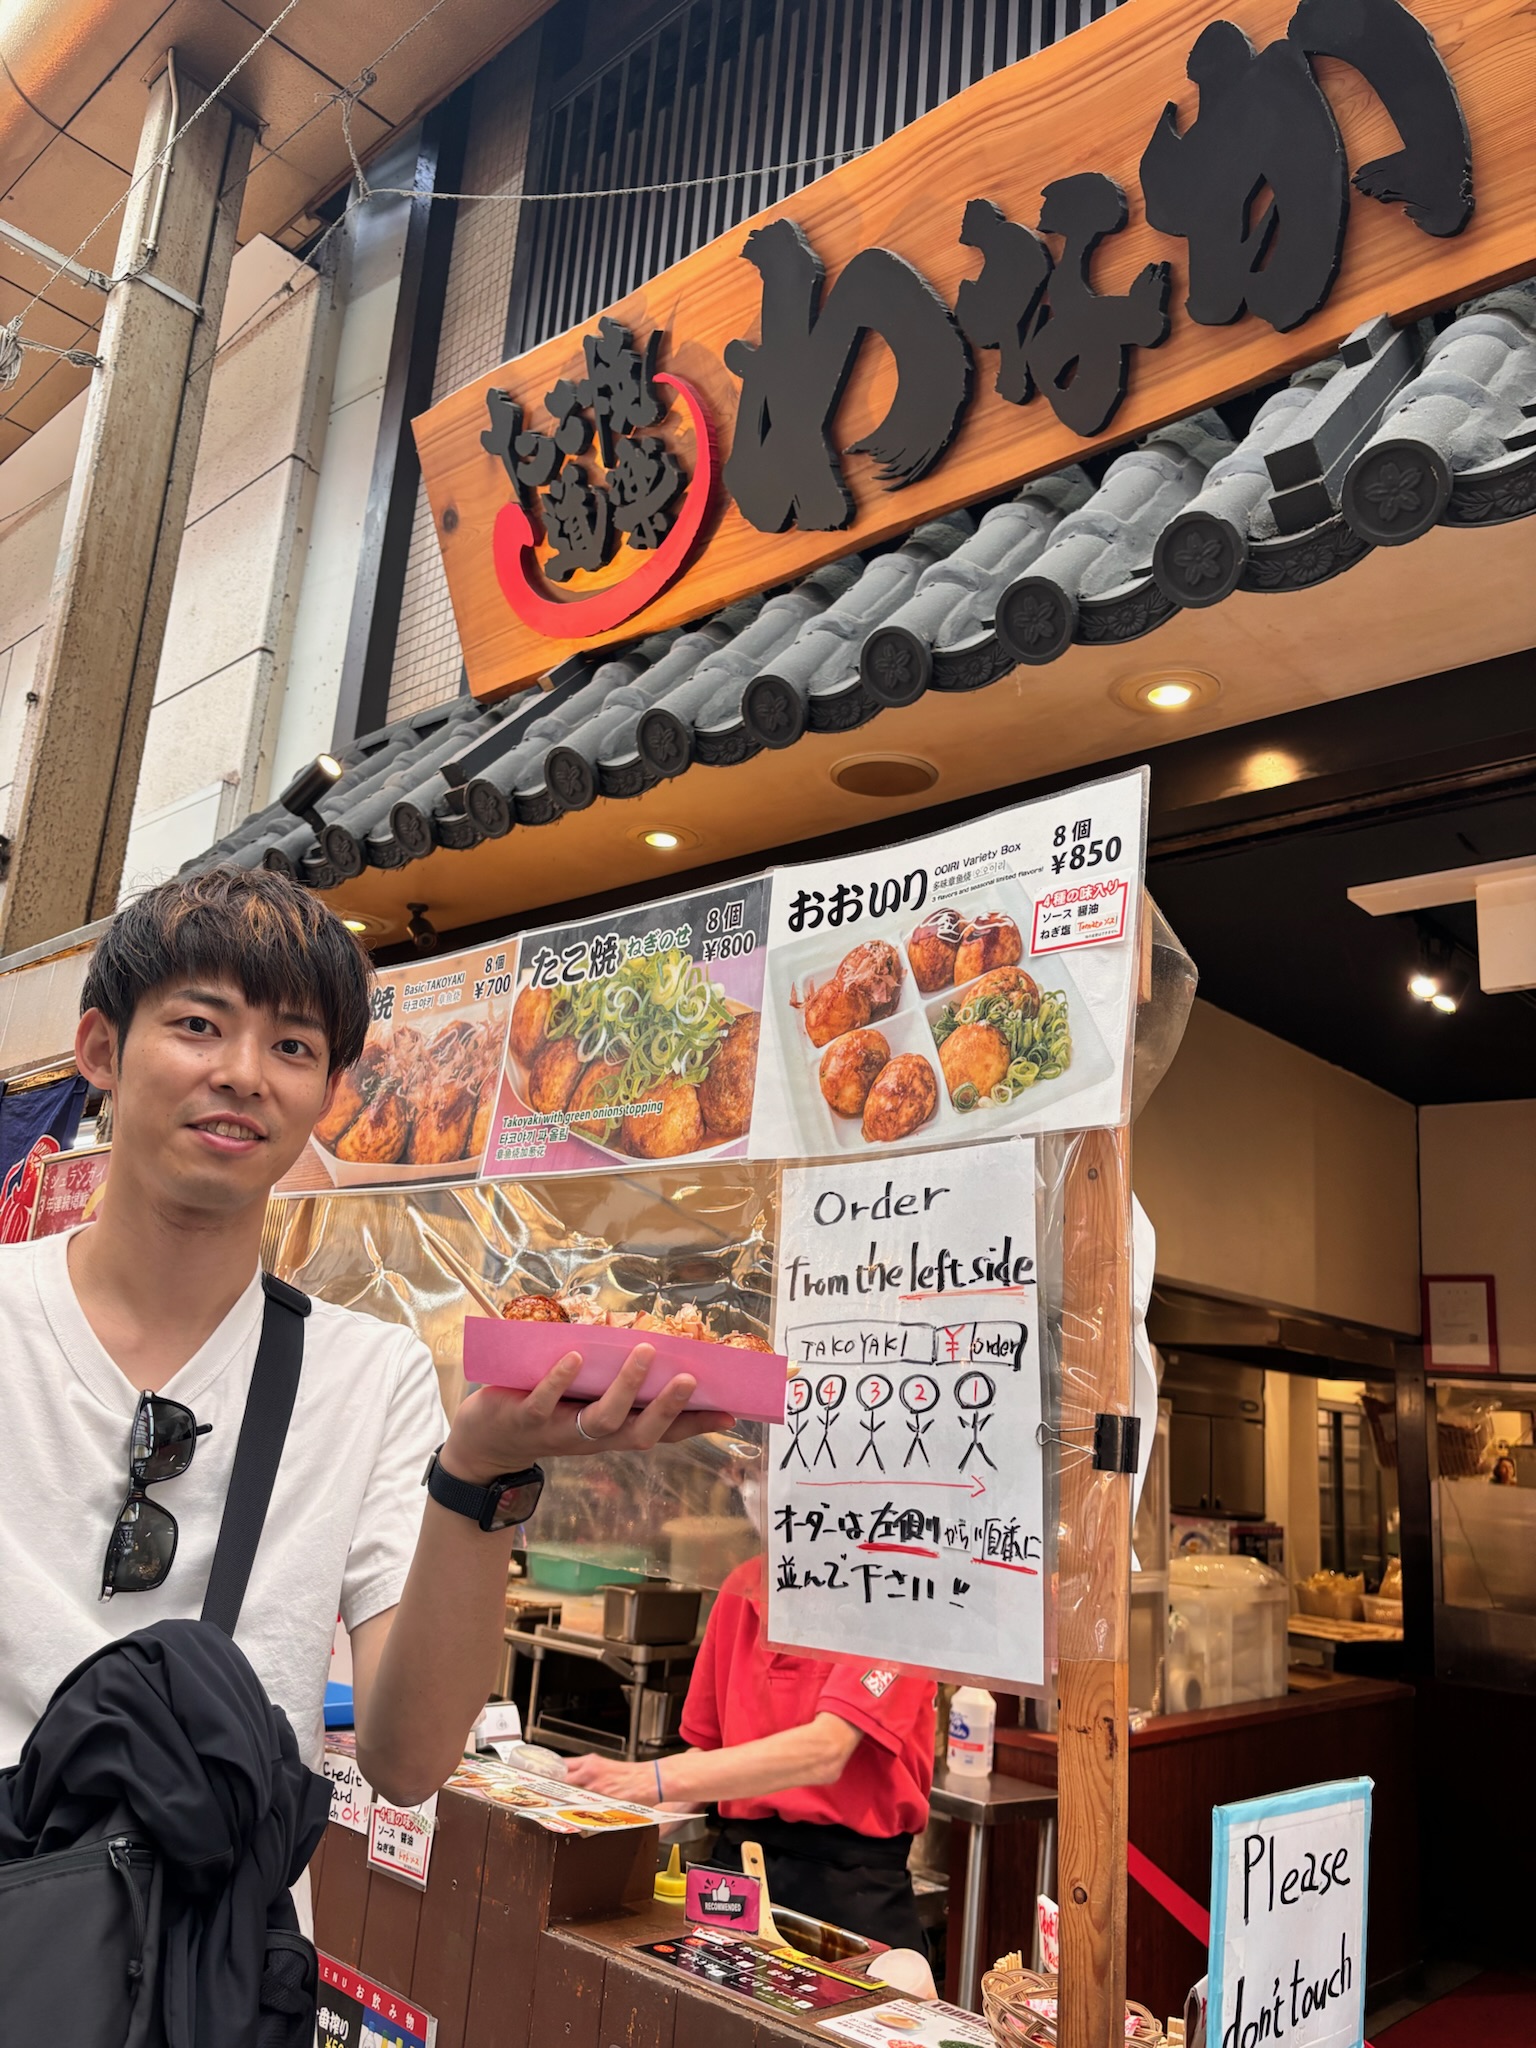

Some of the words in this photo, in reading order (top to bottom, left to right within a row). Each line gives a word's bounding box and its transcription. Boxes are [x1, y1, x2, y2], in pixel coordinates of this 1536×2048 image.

[723, 0, 1476, 533] わなか
[1053, 818, 1091, 847] 8個
[934, 861, 959, 876] OOIRI
[963, 850, 998, 867] Variety
[1001, 843, 1021, 855] Box
[1051, 836, 1121, 875] ¥850
[788, 868, 928, 932] おおいり
[1043, 909, 1072, 923] ソース
[1077, 903, 1099, 917] 醤油
[707, 902, 744, 932] 8個
[704, 932, 755, 961] ¥800
[1040, 925, 1071, 940] ねぎ塩
[485, 955, 506, 974] 8個
[530, 936, 618, 988] たこ焼
[627, 924, 692, 957] ねぎのせ
[404, 983, 425, 996] Basic
[426, 972, 466, 992] TAKOYAKI
[474, 974, 511, 999] ¥700
[503, 1115, 542, 1130] Takoyaki
[543, 1112, 563, 1124] with
[565, 1110, 591, 1124] green
[592, 1106, 623, 1120] onions
[625, 1101, 663, 1117] topping
[814, 1181, 950, 1226] Order
[785, 1255, 849, 1301] from
[856, 1241, 904, 1294] the
[910, 1241, 967, 1293] left
[968, 1236, 1036, 1287] side
[801, 1331, 908, 1363] TAKOYAKI
[944, 1323, 966, 1362] ¥
[323, 1762, 362, 1787] Credit
[332, 1787, 352, 1804] ard
[378, 1825, 396, 1839] ソース
[376, 1841, 396, 1856] ねぎ塩
[1244, 1834, 1350, 1926] Please
[704, 1902, 742, 1912] RECOMMENDED
[1290, 1932, 1352, 2027] touch
[319, 1964, 347, 1988] ENU
[356, 1984, 415, 2031] お飲み物
[317, 2006, 349, 2041] 番搾り
